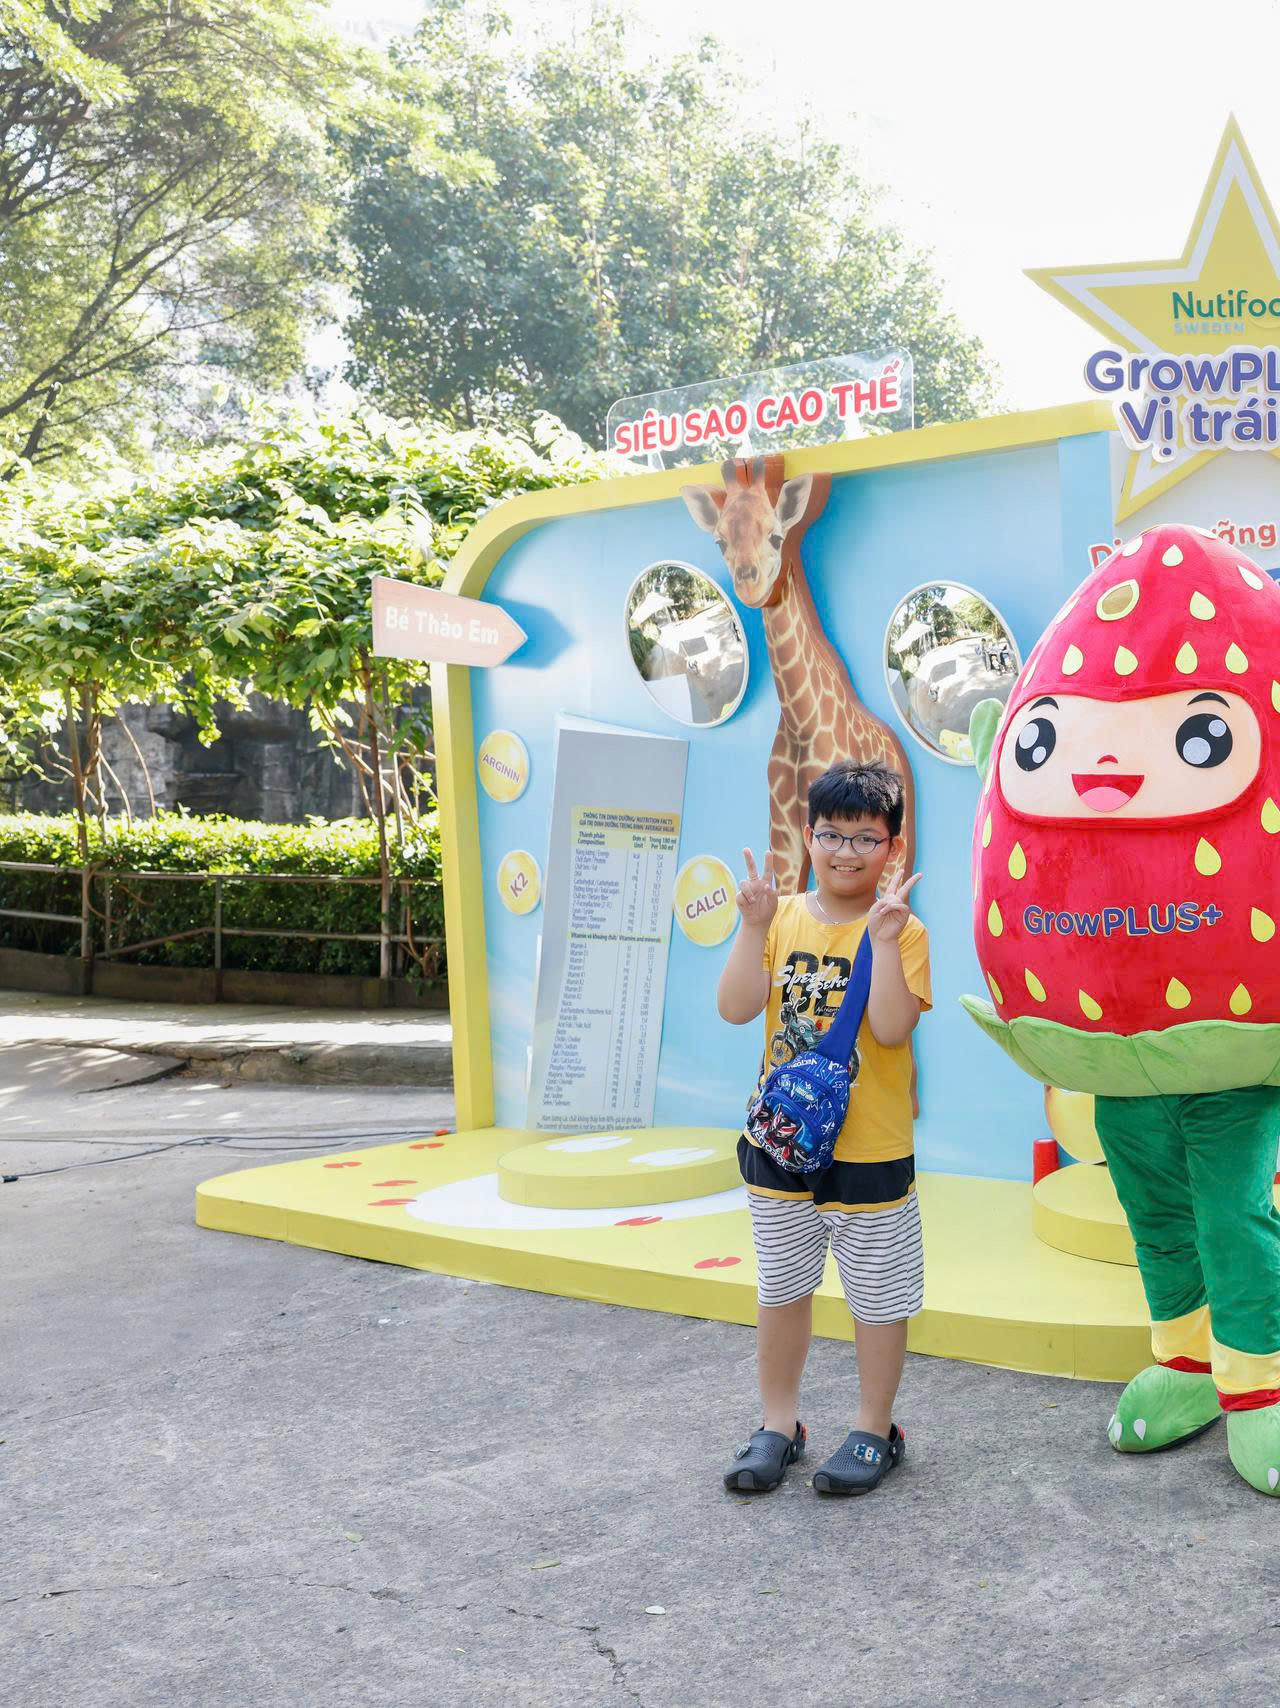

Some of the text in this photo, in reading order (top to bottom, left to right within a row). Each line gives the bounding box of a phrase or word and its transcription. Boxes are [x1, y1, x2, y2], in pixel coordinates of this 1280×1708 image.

[1174, 321, 1245, 335] SWEDEN
[615, 359, 901, 454] SIÊU SAO CAO THẾ
[1119, 397, 1175, 457] Vị
[1190, 398, 1277, 443] trái
[385, 606, 500, 645] Bé Thảo Em
[482, 753, 521, 784] ARGININ
[510, 871, 530, 898] K2
[685, 887, 728, 919] CALCI
[1023, 901, 1224, 937] GrowPLUS+
